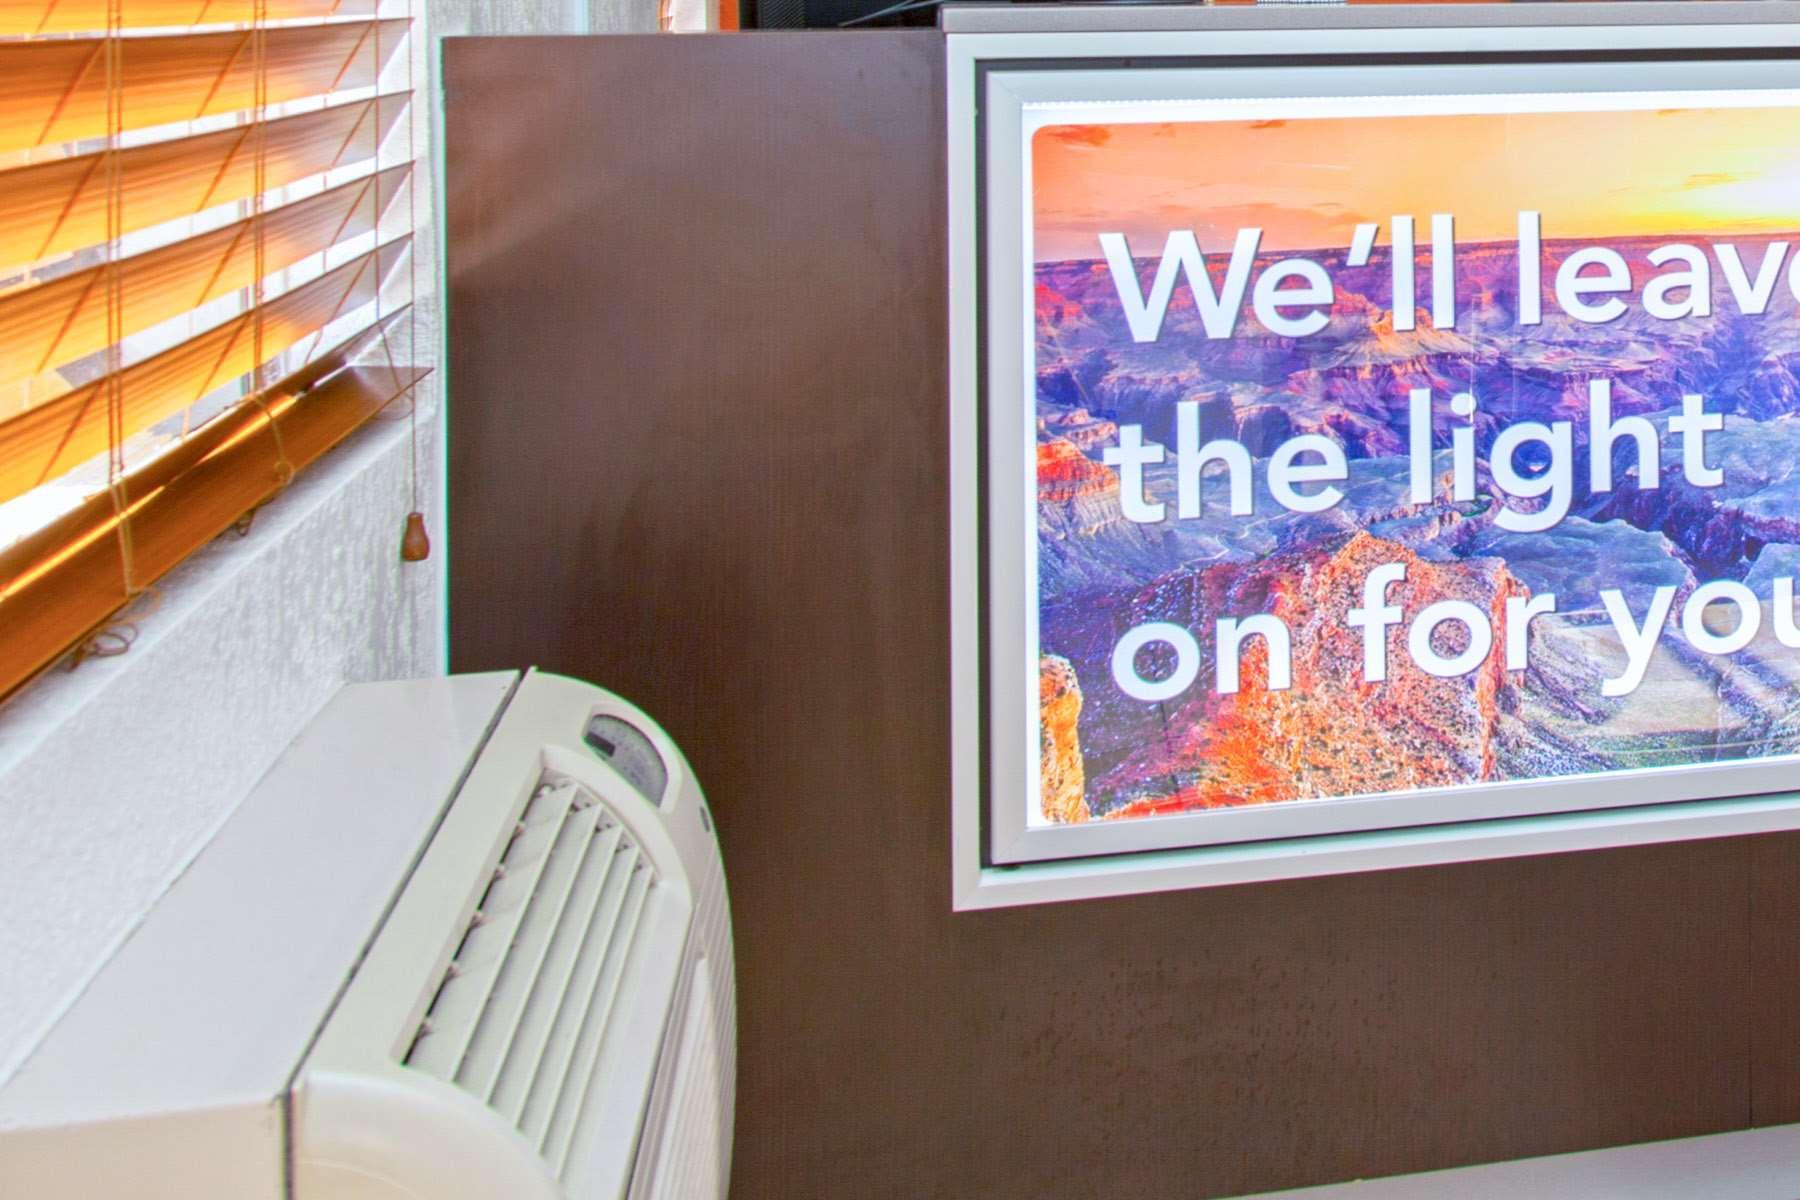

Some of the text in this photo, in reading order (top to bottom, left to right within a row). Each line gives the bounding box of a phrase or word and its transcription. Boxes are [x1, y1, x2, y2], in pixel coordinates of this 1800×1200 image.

[1100, 213, 1456, 344] We'll
[1104, 379, 1725, 532] the light
[1111, 603, 1292, 702] on
[1347, 562, 1556, 682] for
